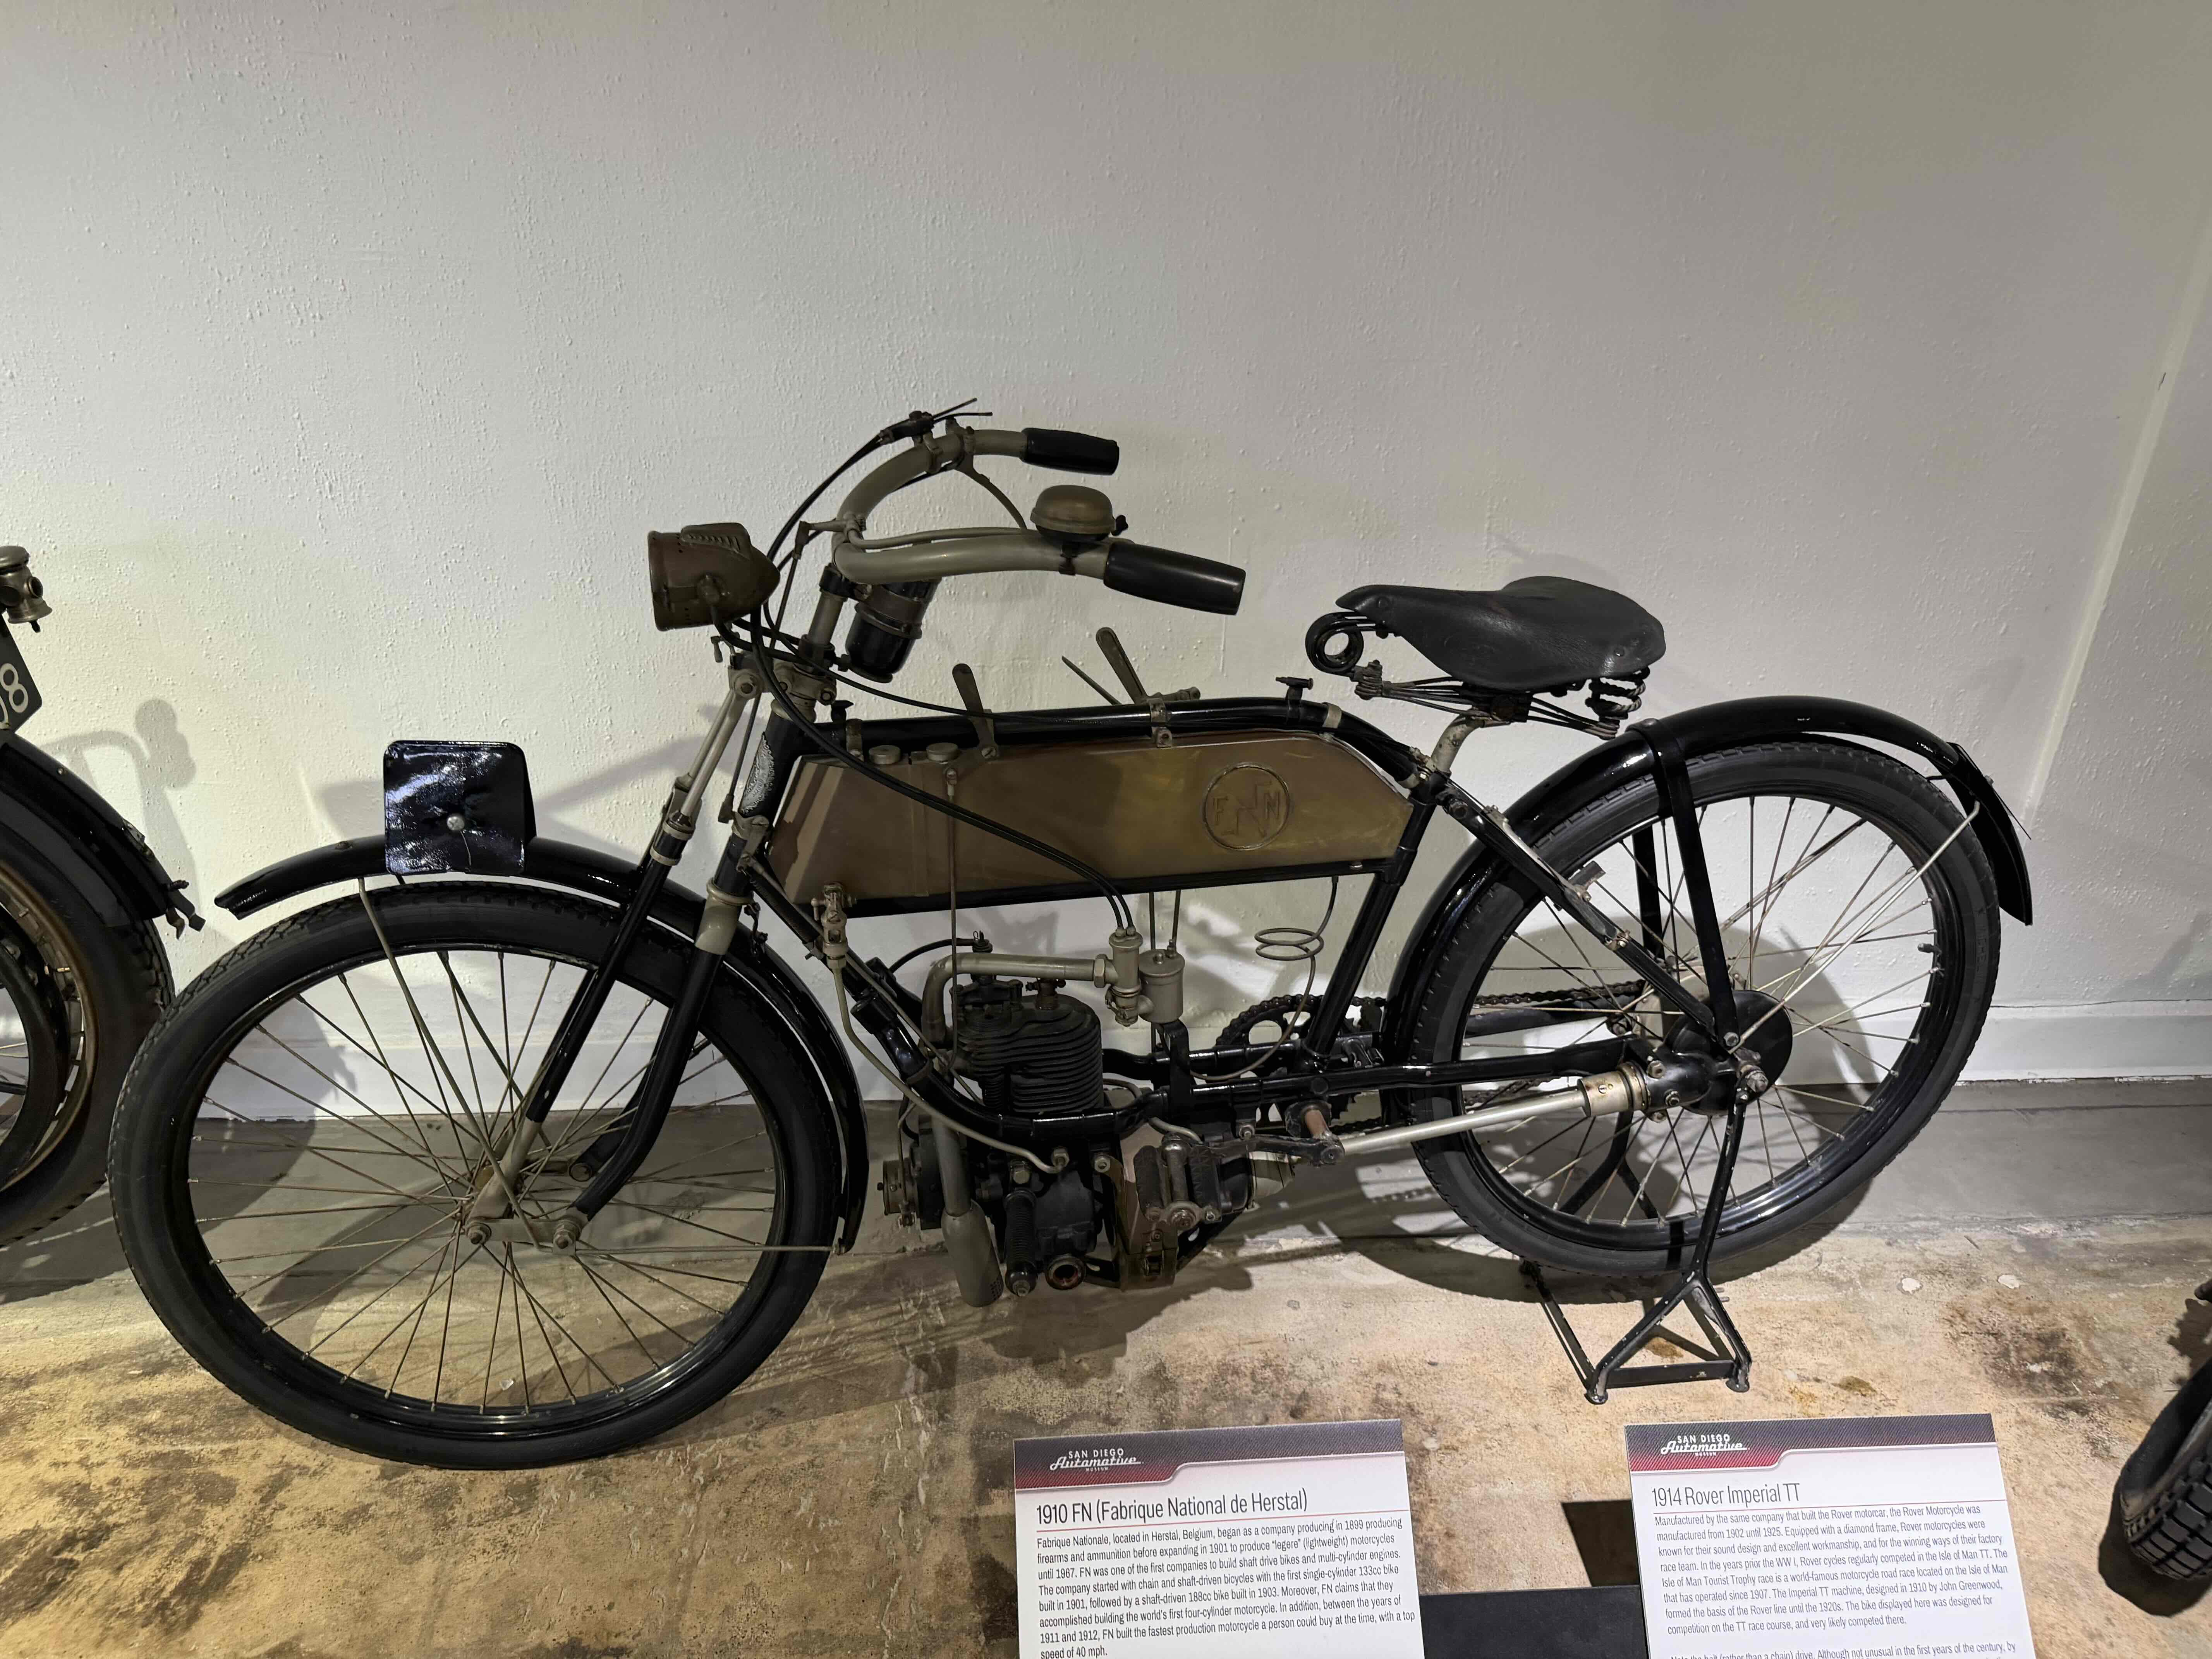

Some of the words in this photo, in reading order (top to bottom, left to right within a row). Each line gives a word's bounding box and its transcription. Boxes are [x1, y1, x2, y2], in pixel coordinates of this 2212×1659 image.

[1677, 1434, 1697, 1444] SAN
[1700, 1434, 1730, 1443] DIEGO
[1068, 1450, 1088, 1459] SAN
[1093, 1448, 1124, 1457] DIEGO
[1036, 1503, 1068, 1525] 1910
[1072, 1502, 1092, 1523] FN
[1096, 1499, 1163, 1524] (Fabrique
[1168, 1494, 1226, 1517] National
[1230, 1493, 1247, 1513] de
[1251, 1487, 1307, 1512] Herstal)
[1652, 1487, 1682, 1507] 1914
[1684, 1487, 1724, 1505] Rover
[1727, 1483, 1781, 1508] Imperial
[1782, 1483, 1800, 1501] TT
[1655, 1514, 1704, 1526] Manufactured
[1706, 1514, 1715, 1526] by
[1716, 1513, 1728, 1524] the
[1730, 1515, 1750, 1523] same
[1752, 1513, 1784, 1524] company
[1786, 1511, 1800, 1522] that
[1801, 1510, 1817, 1520] built
[1818, 1510, 1829, 1520] the
[1831, 1510, 1853, 1519] Rover
[1854, 1509, 1888, 1518] motorcar,
[1889, 1507, 1901, 1517] the
[1903, 1507, 1924, 1516] Rover
[1925, 1504, 1965, 1517] Motorcycle
[1037, 1536, 1071, 1549] Fabrique
[1073, 1534, 1111, 1546] Nationale,
[1113, 1531, 1140, 1544] located
[1142, 1531, 1149, 1542] in
[1151, 1529, 1180, 1542] Herstal,
[1183, 1527, 1215, 1541] Belgium,
[1217, 1527, 1241, 1539] began
[1243, 1528, 1252, 1537] as
[1254, 1527, 1259, 1535] a
[1261, 1525, 1295, 1537] company
[1297, 1521, 1334, 1535] producing
[1336, 1520, 1343, 1531] in
[1345, 1519, 1363, 1530] 1899
[1366, 1517, 1402, 1532] producing
[1657, 1529, 1706, 1541] manufactured
[1707, 1529, 1725, 1539] from
[1726, 1528, 1745, 1539] 1902
[1746, 1527, 1761, 1538] until
[1762, 1527, 1784, 1537] 1925.
[1784, 1525, 1819, 1538] Equipped
[1820, 1524, 1835, 1535] with
[1843, 1523, 1874, 1534] diamond
[1875, 1522, 1899, 1533] frame,
[1900, 1522, 1922, 1532] Rover
[1923, 1519, 1967, 1532] motorcycles
[1967, 1521, 1985, 1529] were
[1037, 1553, 1068, 1564] firearms
[1070, 1550, 1085, 1563] and
[1087, 1548, 1131, 1562] ammunition
[1133, 1546, 1157, 1558] before
[1159, 1544, 1199, 1558] expanding
[1200, 1543, 1207, 1554] in
[1209, 1543, 1229, 1554] 1901
[1230, 1542, 1237, 1553] to
[1239, 1540, 1270, 1554] produce
[1303, 1535, 1348, 1551] (lightweight)
[1350, 1532, 1395, 1546] motorcycles
[1658, 1546, 1682, 1557] known
[1683, 1545, 1694, 1556] for
[1695, 1544, 1712, 1555] their
[1713, 1543, 1736, 1554] sound
[1737, 1542, 1761, 1555] design
[1763, 1542, 1777, 1553] and
[1779, 1541, 1810, 1552] excellent
[1812, 1539, 1862, 1551] workmanship,
[1863, 1538, 1877, 1549] and
[1878, 1537, 1888, 1548] for
[1889, 1537, 1902, 1547] the
[1903, 1536, 1931, 1548] winning
[1932, 1537, 1951, 1547] ways
[1952, 1534, 1959, 1545] of
[1960, 1534, 1977, 1545] their
[1978, 1533, 2002, 1546] factory
[1038, 1567, 1054, 1580] until
[1079, 1566, 1091, 1578] FN
[1092, 1567, 1109, 1577] was
[1111, 1566, 1125, 1576] one
[1127, 1563, 1135, 1575] of
[1136, 1563, 1149, 1574] the
[1150, 1562, 1164, 1574] first
[1166, 1559, 1207, 1574] companies
[1209, 1559, 1217, 1570] to
[1219, 1557, 1237, 1569] build
[1239, 1556, 1257, 1568] shaft
[1259, 1555, 1278, 1566] drive
[1279, 1554, 1300, 1565] bikes
[1302, 1553, 1316, 1564] and
[1318, 1550, 1367, 1564] multi-cylinder
[1370, 1549, 1401, 1562] engines.
[1038, 1584, 1054, 1596] The
[1056, 1584, 1091, 1596] company
[1092, 1580, 1119, 1592] started
[1120, 1579, 1136, 1591] with
[1138, 1578, 1159, 1590] chain
[1161, 1577, 1175, 1589] and
[1177, 1574, 1222, 1587] shaft-driven
[1224, 1572, 1254, 1586] bicycles
[1255, 1570, 1271, 1582] with
[1273, 1570, 1285, 1581] the
[1287, 1570, 1301, 1580] first
[1303, 1566, 1357, 1581] single-cylinder
[1358, 1565, 1381, 1576] 133cc
[1383, 1563, 1399, 1575] bike
[1039, 1600, 1055, 1612] built
[1057, 1599, 1064, 1611] in
[1065, 1598, 1087, 1611] 1901,
[1089, 1595, 1121, 1609] followed
[1123, 1595, 1133, 1609] by
[1135, 1597, 1140, 1606] a
[1142, 1592, 1186, 1605] shaft-driven
[1188, 1591, 1212, 1602] 188cc
[1213, 1589, 1229, 1601] bike
[1231, 1588, 1247, 1600] built
[1249, 1587, 1255, 1599] in
[1257, 1587, 1279, 1598] 1903.
[1281, 1586, 1319, 1597] Moreover,
[1321, 1583, 1333, 1595] FN
[1335, 1582, 1359, 1594] claims
[1361, 1581, 1376, 1592] that
[1377, 1580, 1393, 1592] they
[1668, 1623, 1709, 1636] competition
[1711, 1625, 1721, 1633] on
[1723, 1621, 1735, 1632] the
[1735, 1621, 1746, 1632] TT
[1748, 1622, 1765, 1631] race
[1766, 1621, 1793, 1630] course,
[1795, 1618, 1809, 1629] and
[1810, 1620, 1826, 1630] very
[1828, 1617, 1846, 1629] likely
[1848, 1615, 1884, 1628] competed
[1885, 1614, 1906, 1625] there.
